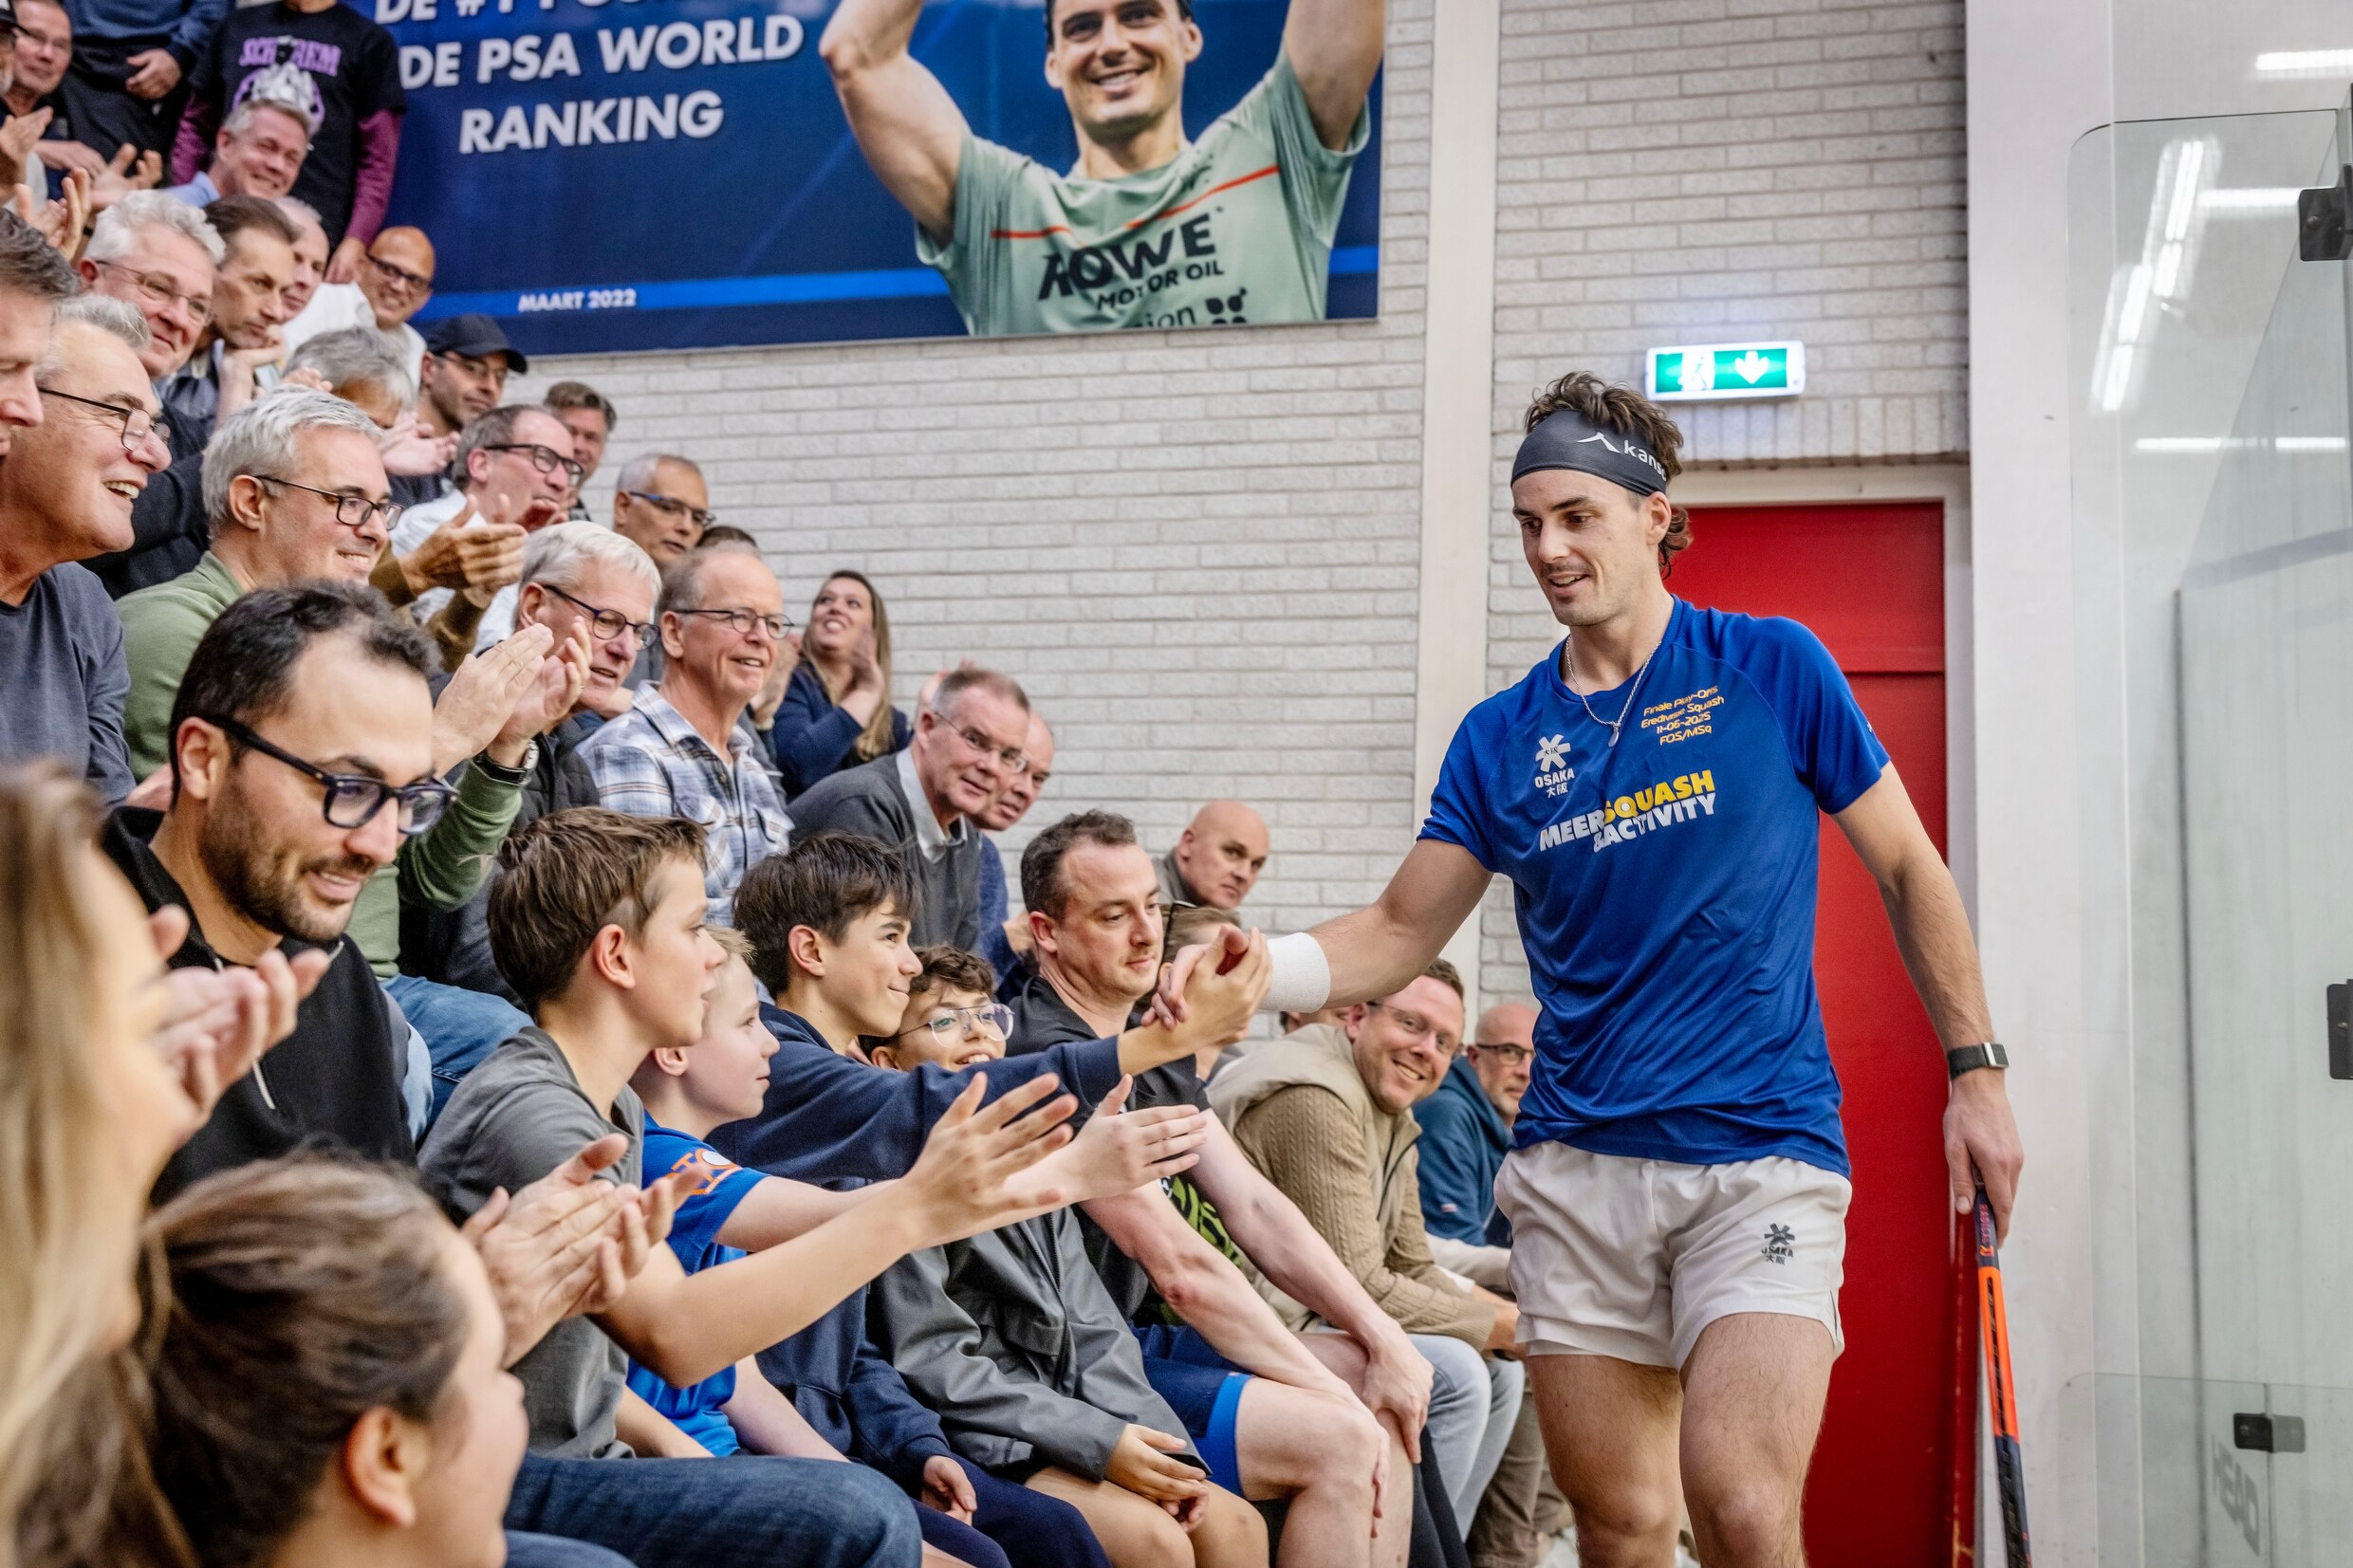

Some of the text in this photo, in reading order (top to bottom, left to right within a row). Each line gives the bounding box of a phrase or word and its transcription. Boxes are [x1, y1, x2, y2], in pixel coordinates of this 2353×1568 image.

[398, 14, 805, 89] DE PSA WORLD
[459, 89, 725, 155] RANKING
[1186, 260, 1225, 280] OIL
[518, 287, 637, 312] MAART 2022
[1643, 702, 1673, 717] Finale
[1687, 695, 1725, 713] Squash
[1656, 710, 1712, 734] 11-06-2025
[1534, 767, 1576, 788] OSAKA
[1547, 782, 1568, 799] 大阪
